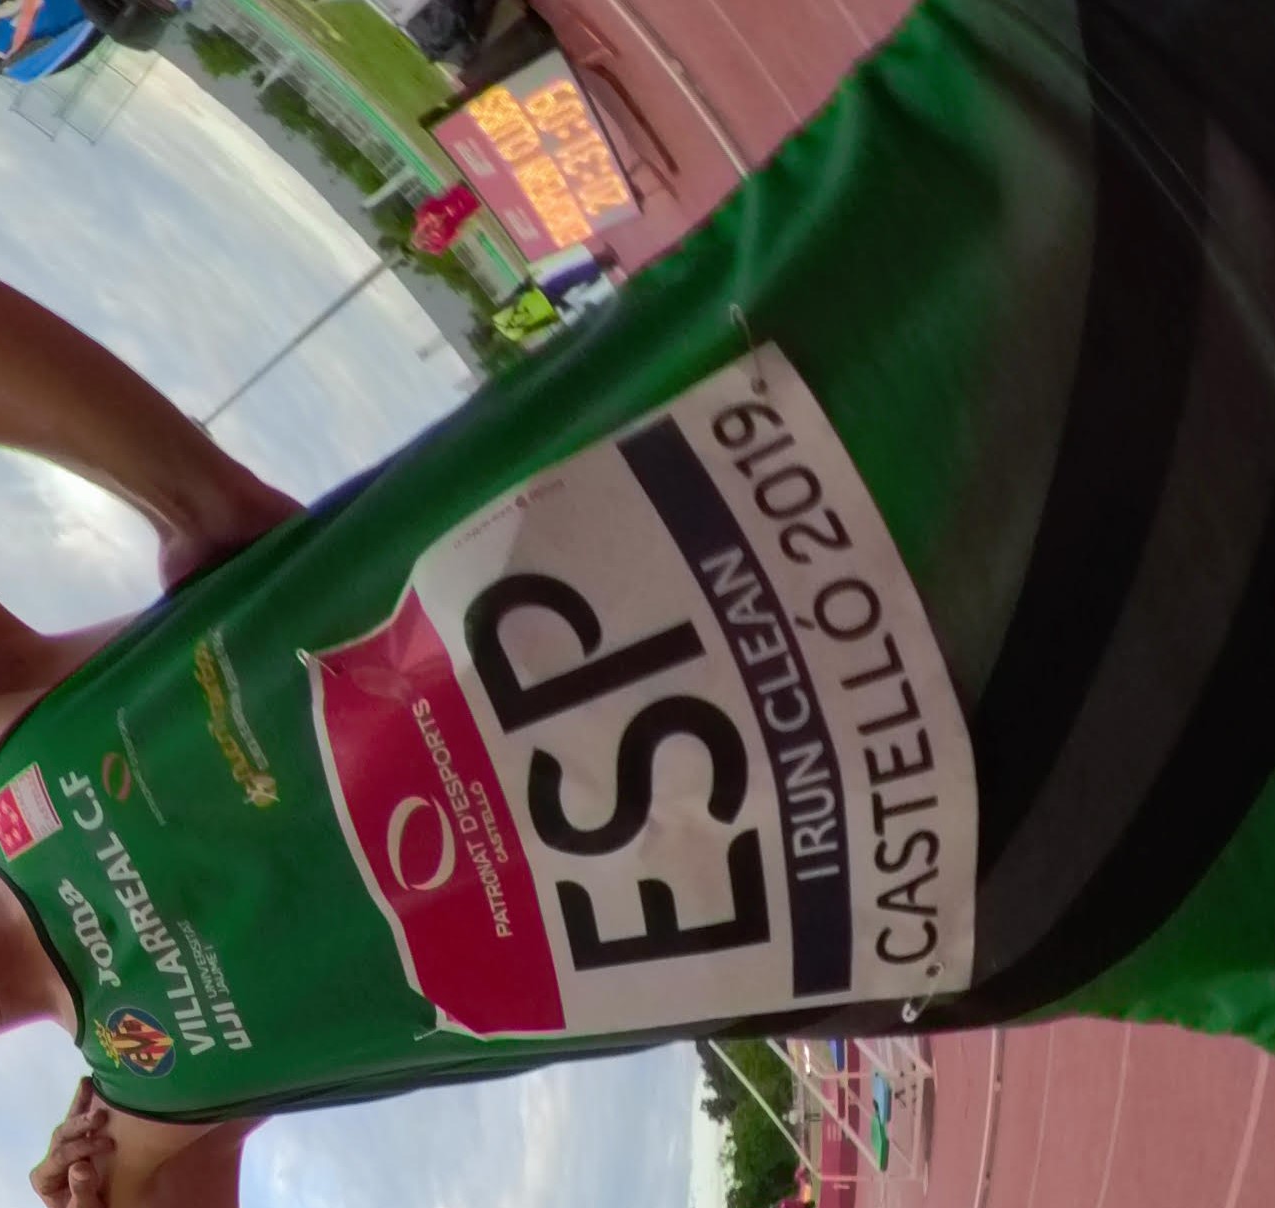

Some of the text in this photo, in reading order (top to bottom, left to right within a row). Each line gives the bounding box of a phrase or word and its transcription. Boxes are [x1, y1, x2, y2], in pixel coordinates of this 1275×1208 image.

[699, 545, 811, 733] CLEAN
[712, 402, 940, 966] CASTELLÓ 2019
[411, 697, 514, 938] PATRONAT D'ESPORTS
[464, 573, 772, 972] ESP
[96, 830, 217, 1057] VILLARREAL
